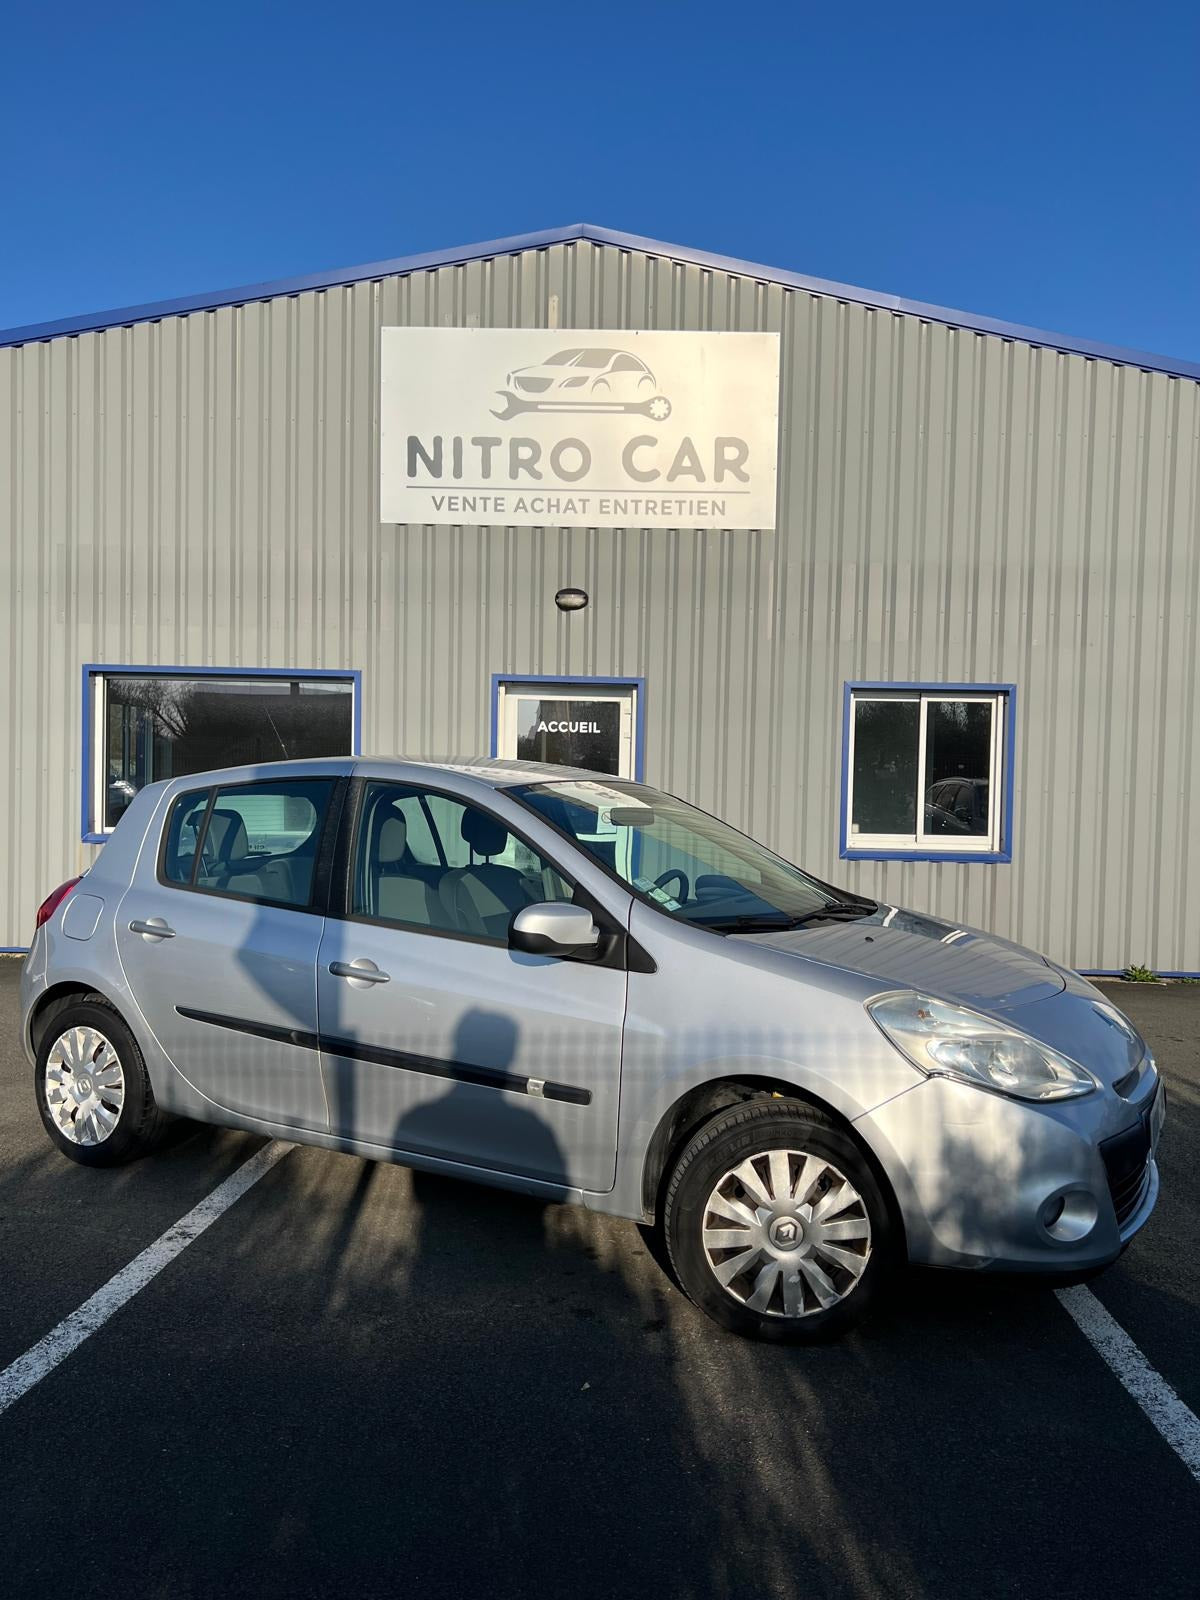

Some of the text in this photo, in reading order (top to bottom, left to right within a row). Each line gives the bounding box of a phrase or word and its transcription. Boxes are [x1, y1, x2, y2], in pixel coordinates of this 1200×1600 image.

[406, 435, 750, 483] NITRO CAR
[431, 495, 726, 517] VENTE ACHAT ENTRETIEN
[537, 720, 601, 734] ACCUEIL
